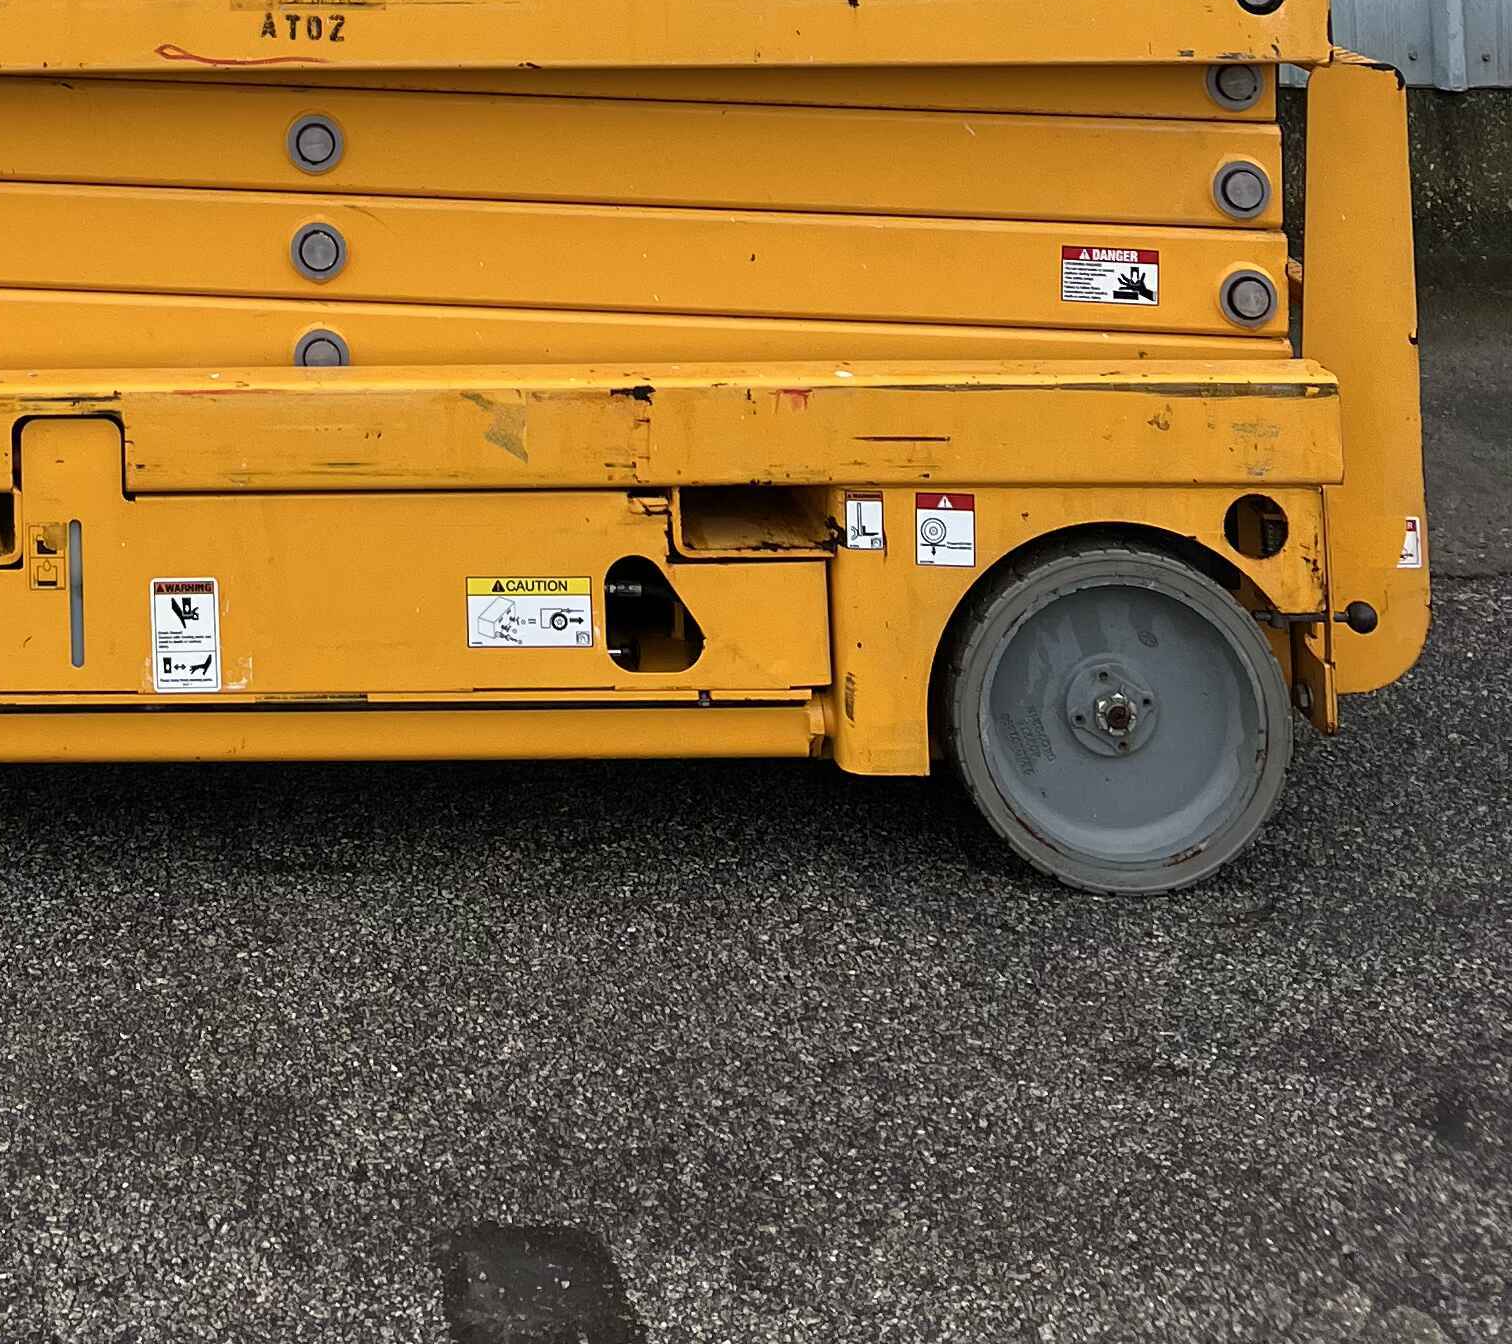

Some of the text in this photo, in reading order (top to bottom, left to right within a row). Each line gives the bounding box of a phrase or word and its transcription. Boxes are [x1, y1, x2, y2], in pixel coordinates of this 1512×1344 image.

[1091, 248, 1139, 262] DANGER
[165, 583, 213, 593] WARNING
[505, 579, 569, 593] CAUTION
